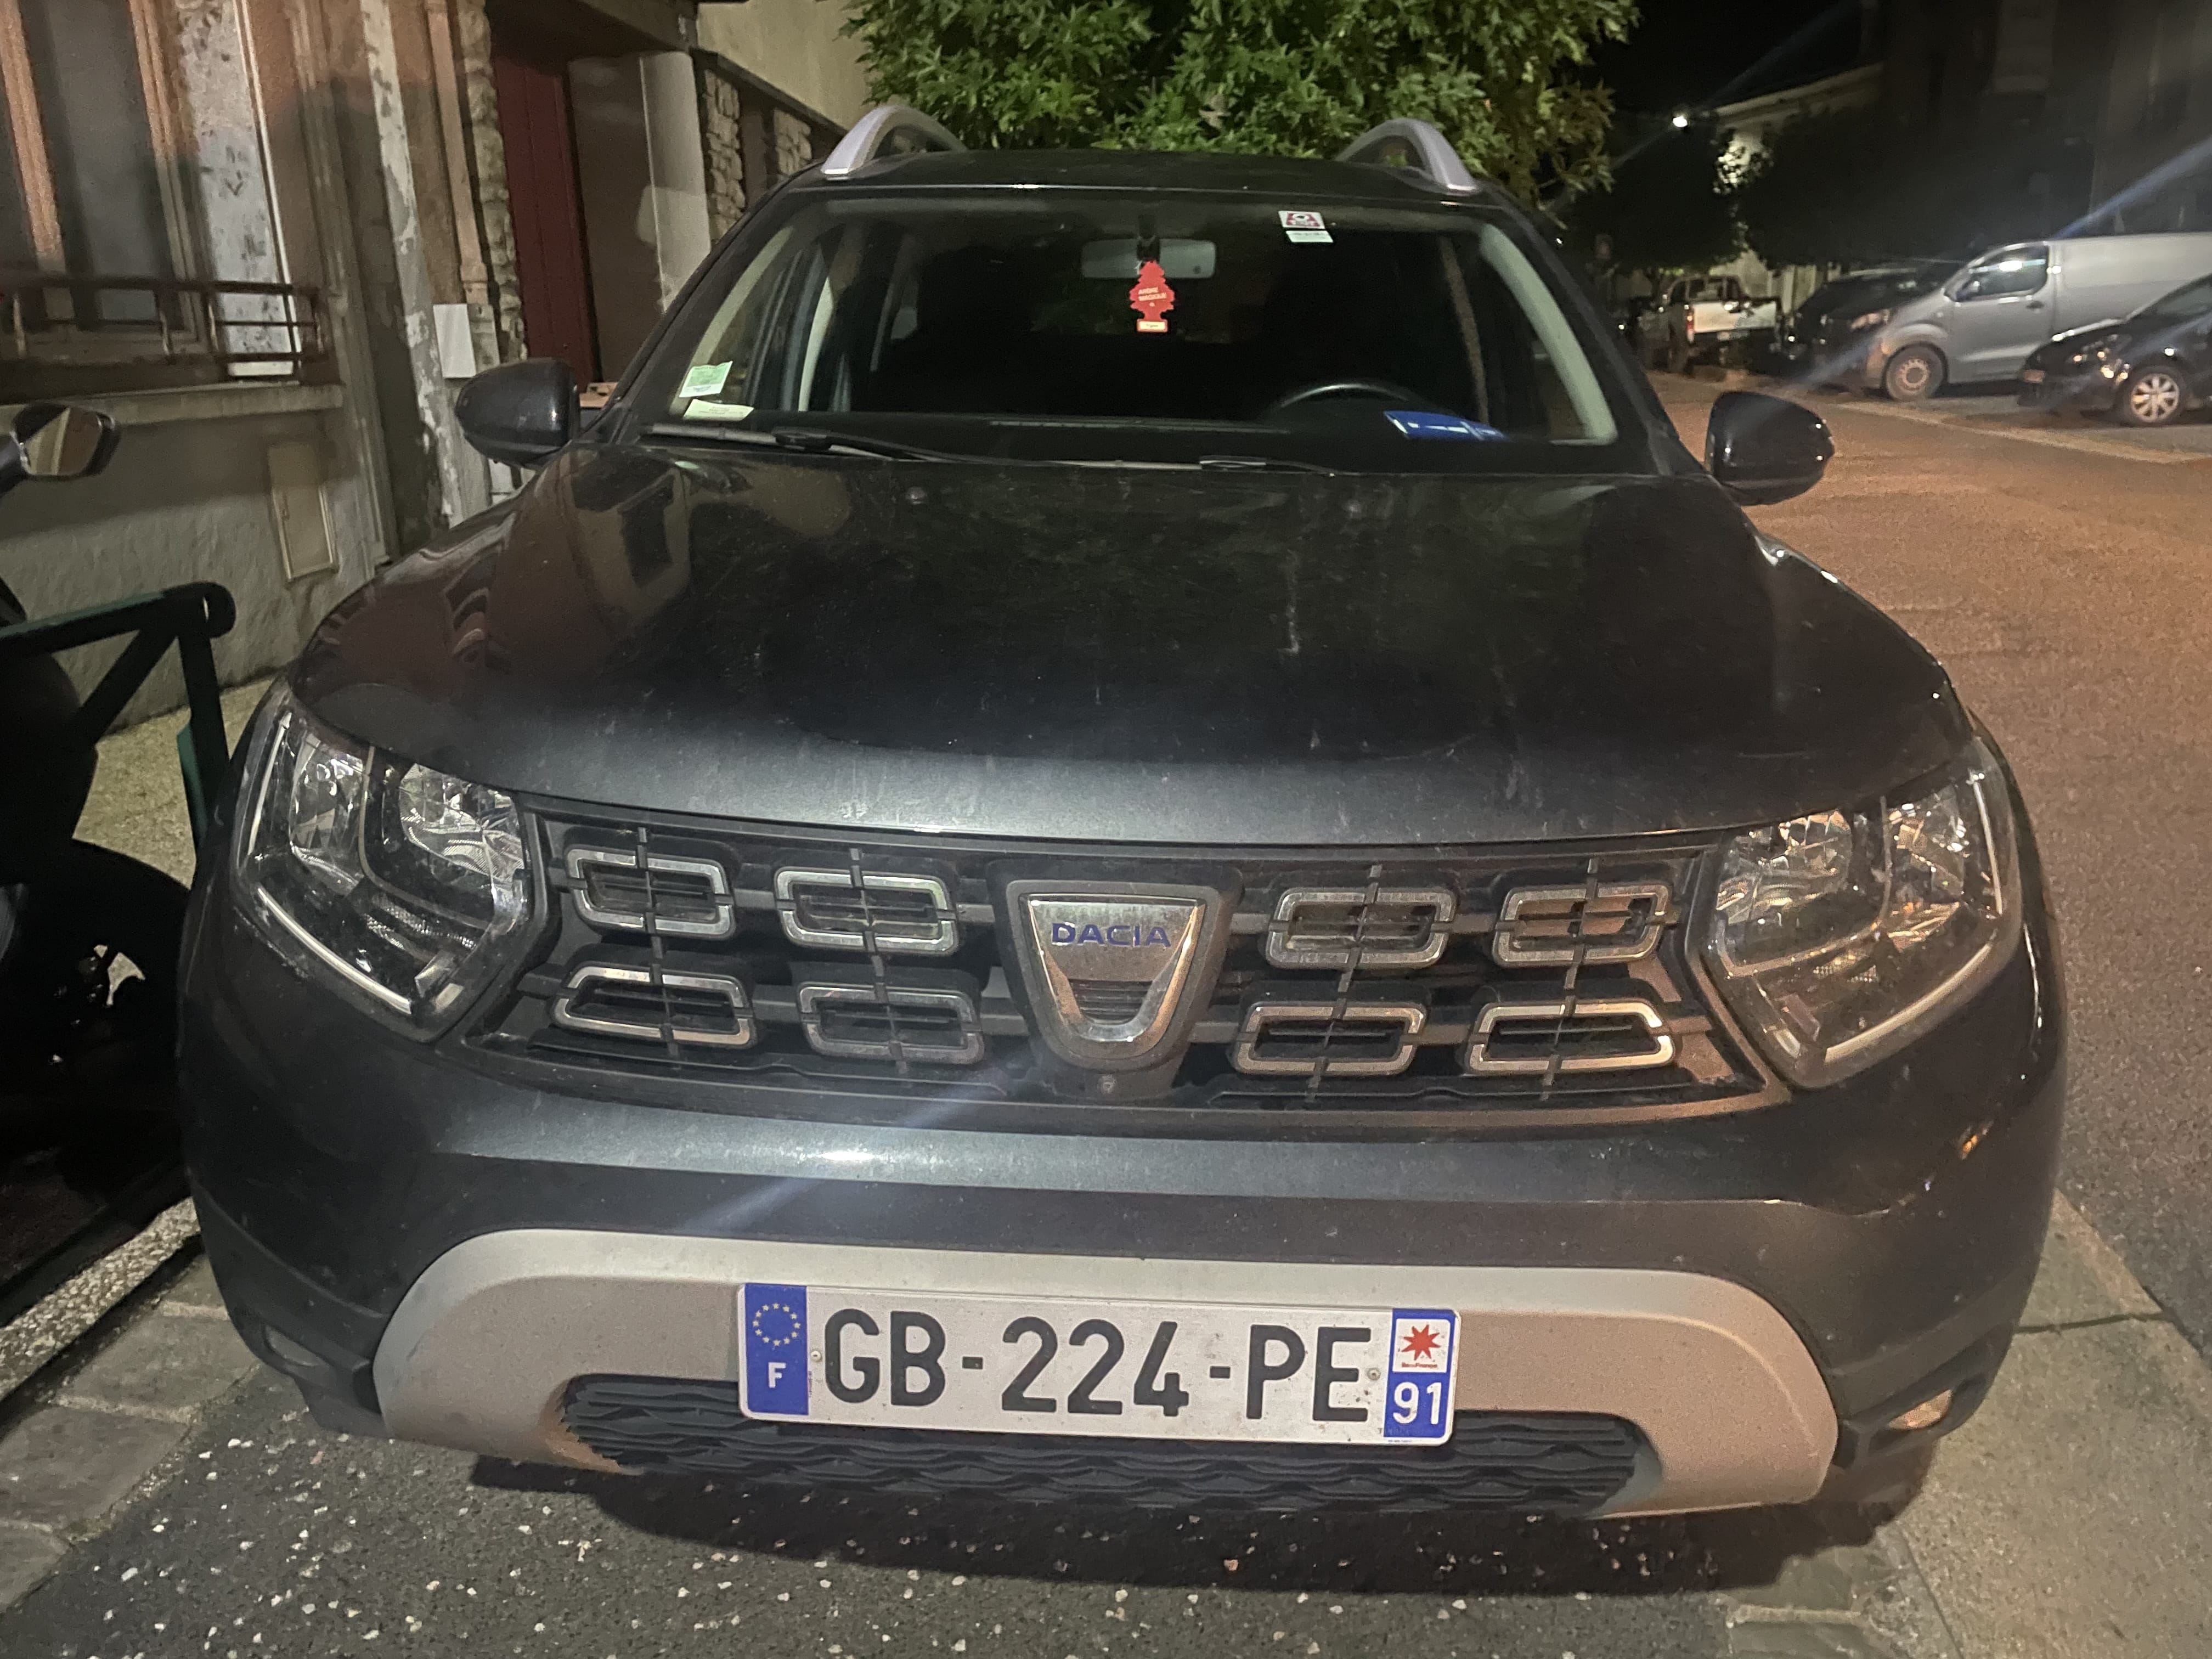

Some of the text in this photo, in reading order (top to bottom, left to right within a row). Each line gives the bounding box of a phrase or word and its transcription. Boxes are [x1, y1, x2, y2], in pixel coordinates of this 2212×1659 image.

[1052, 922, 1171, 947] DACIA
[769, 1362, 786, 1389] F
[824, 1308, 1372, 1423] GB-224-PE
[1393, 1381, 1442, 1425] 91
